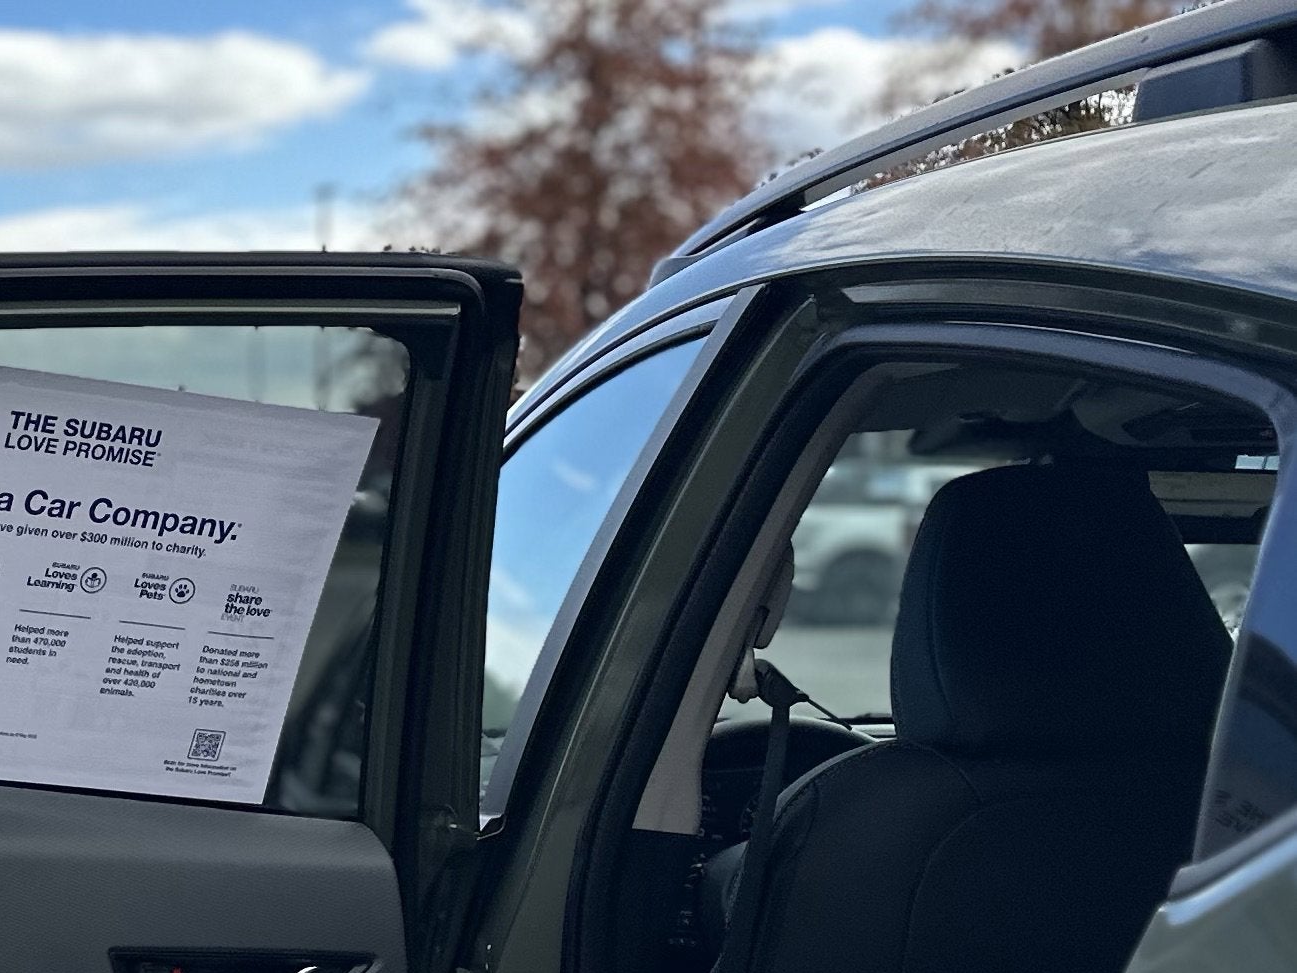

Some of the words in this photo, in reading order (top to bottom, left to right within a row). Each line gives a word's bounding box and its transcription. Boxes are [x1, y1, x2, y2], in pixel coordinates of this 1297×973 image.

[11, 411, 58, 435] THE
[64, 418, 162, 448] SUBARU
[4, 433, 59, 455] LOVE
[24, 489, 81, 520] Car
[16, 524, 49, 536] given
[52, 529, 77, 540] over
[80, 531, 108, 544] $300
[110, 536, 148, 549] million
[151, 541, 163, 550] to
[166, 542, 206, 558] charity.
[45, 568, 77, 580] Loves
[27, 576, 75, 592] Learning
[134, 578, 166, 591] Loves
[139, 590, 163, 600] Pets
[227, 593, 262, 605] share
[246, 606, 270, 617] love
